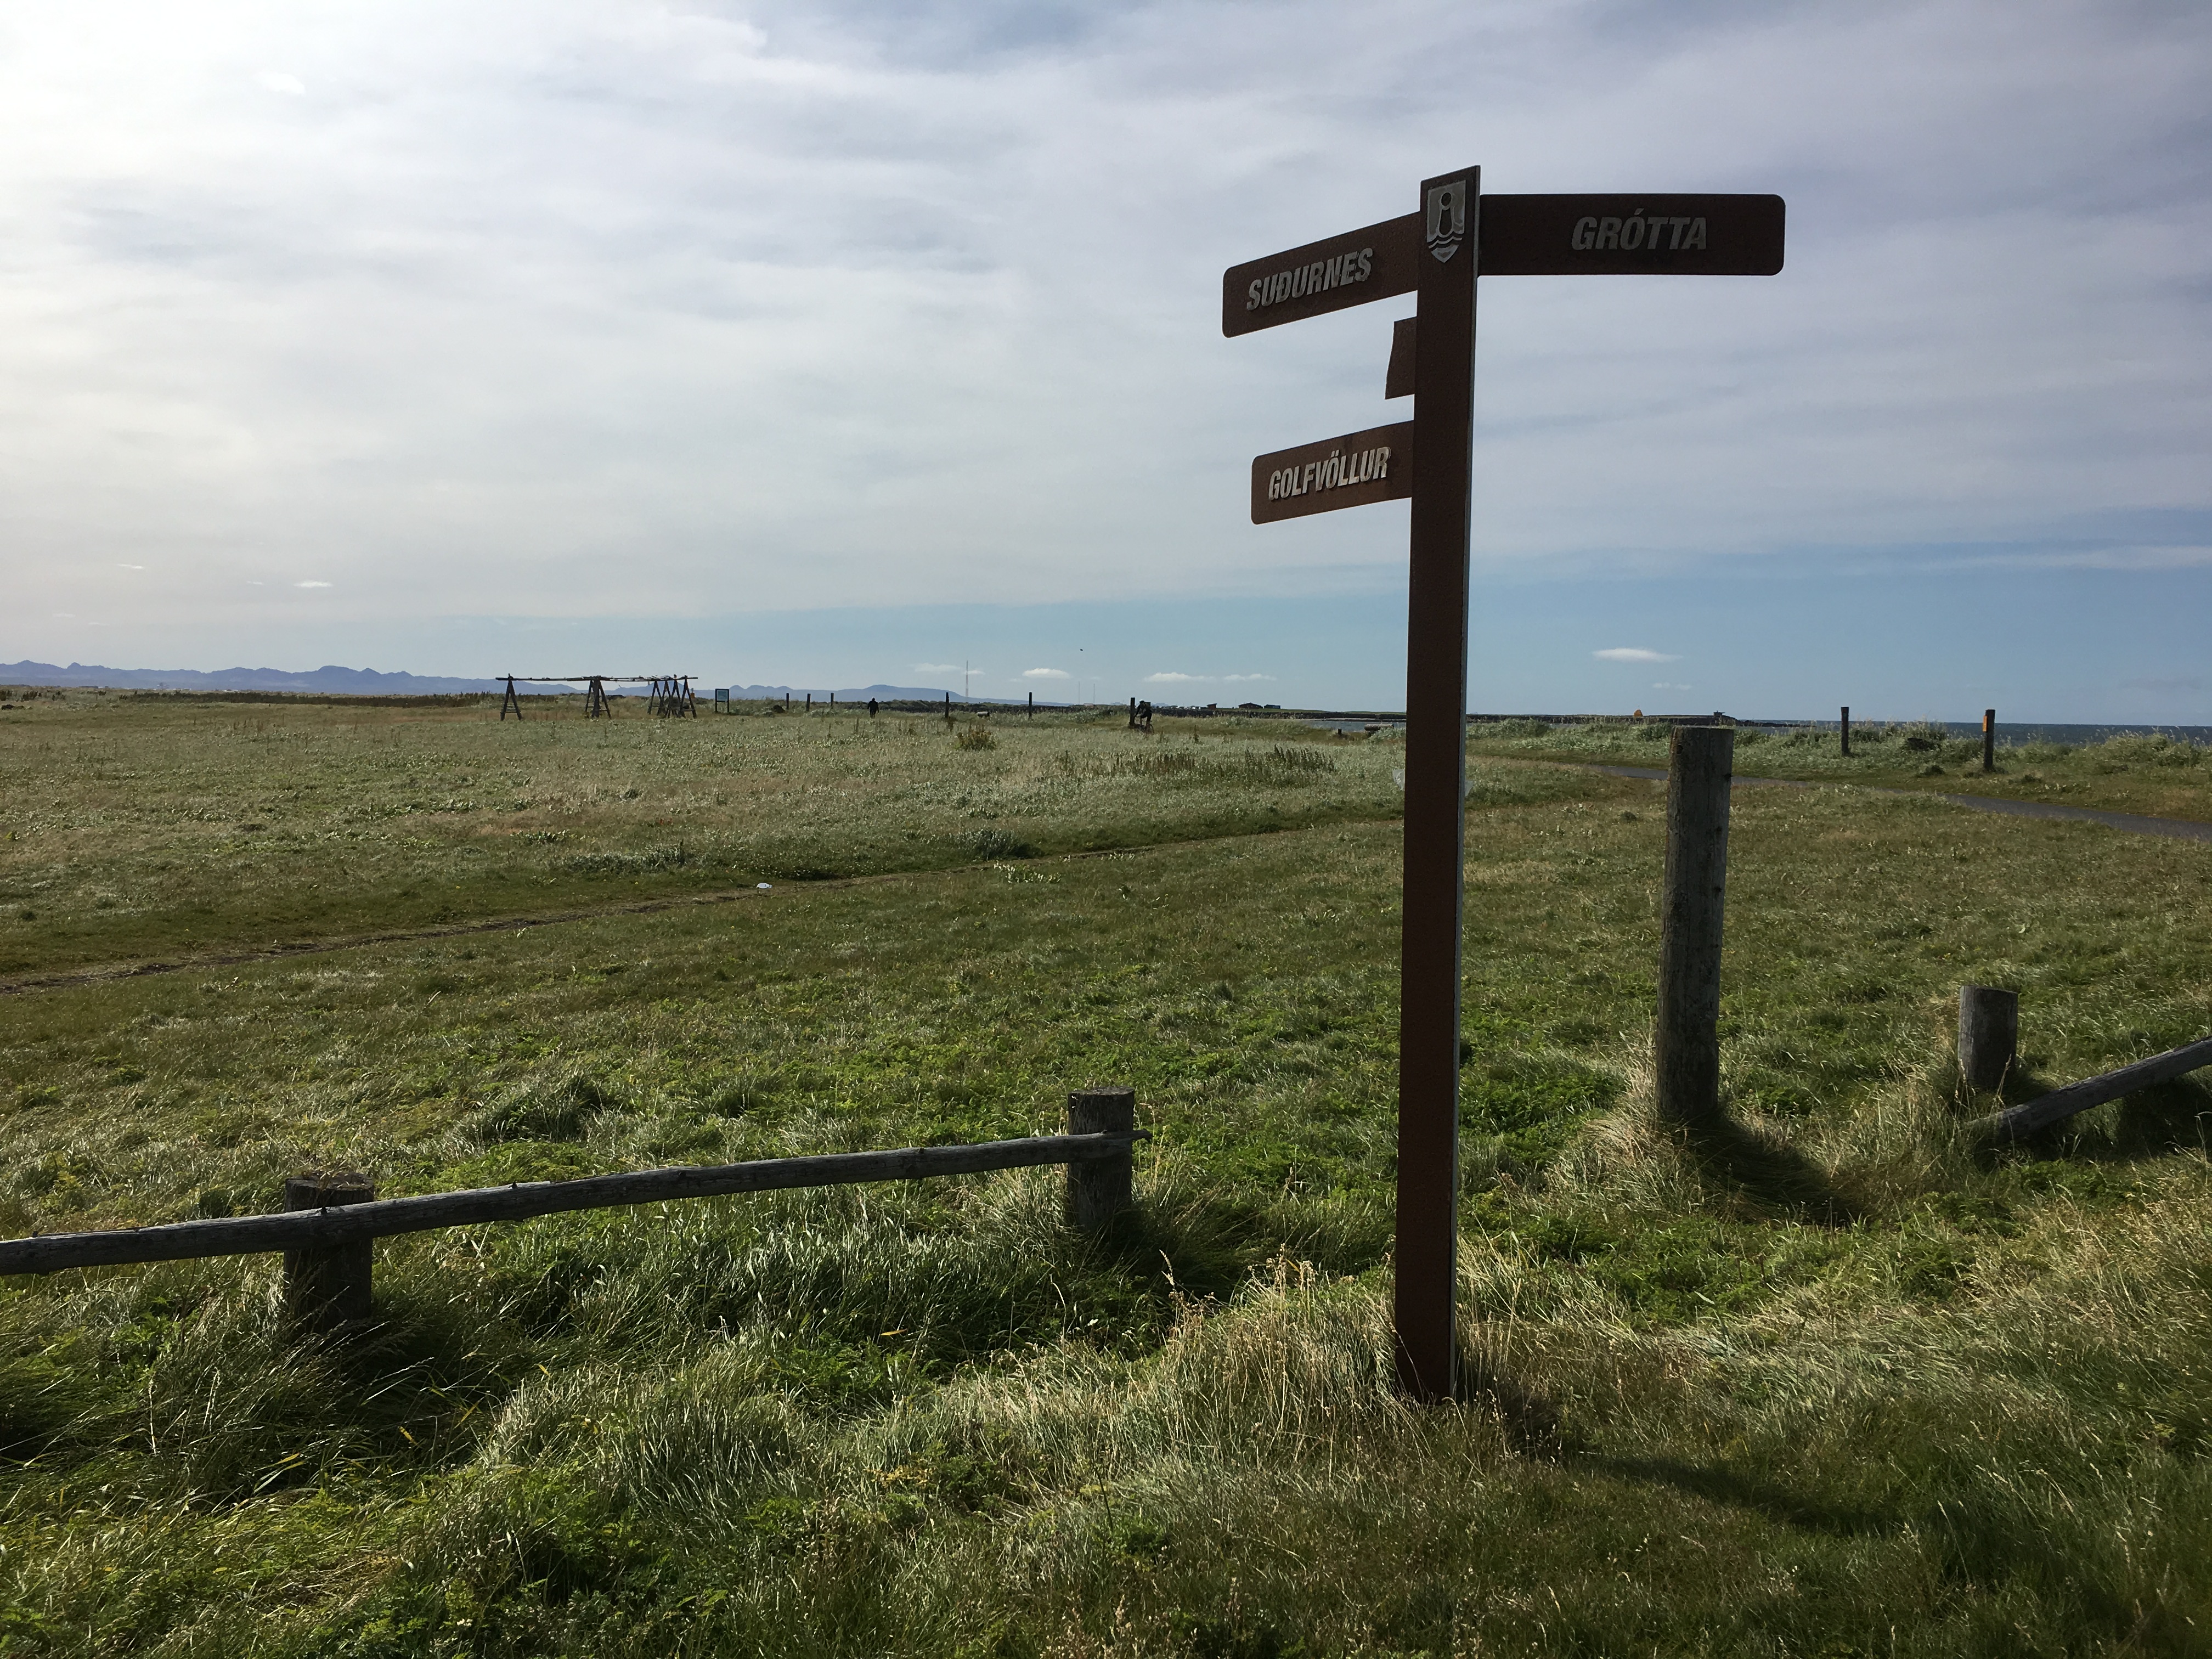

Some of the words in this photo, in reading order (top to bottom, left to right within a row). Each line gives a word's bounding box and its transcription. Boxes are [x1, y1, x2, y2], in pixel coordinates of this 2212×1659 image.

[1571, 208, 1707, 250] GRÓTTA
[1246, 247, 1373, 311] SUÐURNES
[1268, 447, 1391, 500] GOLFVÖLLUR
